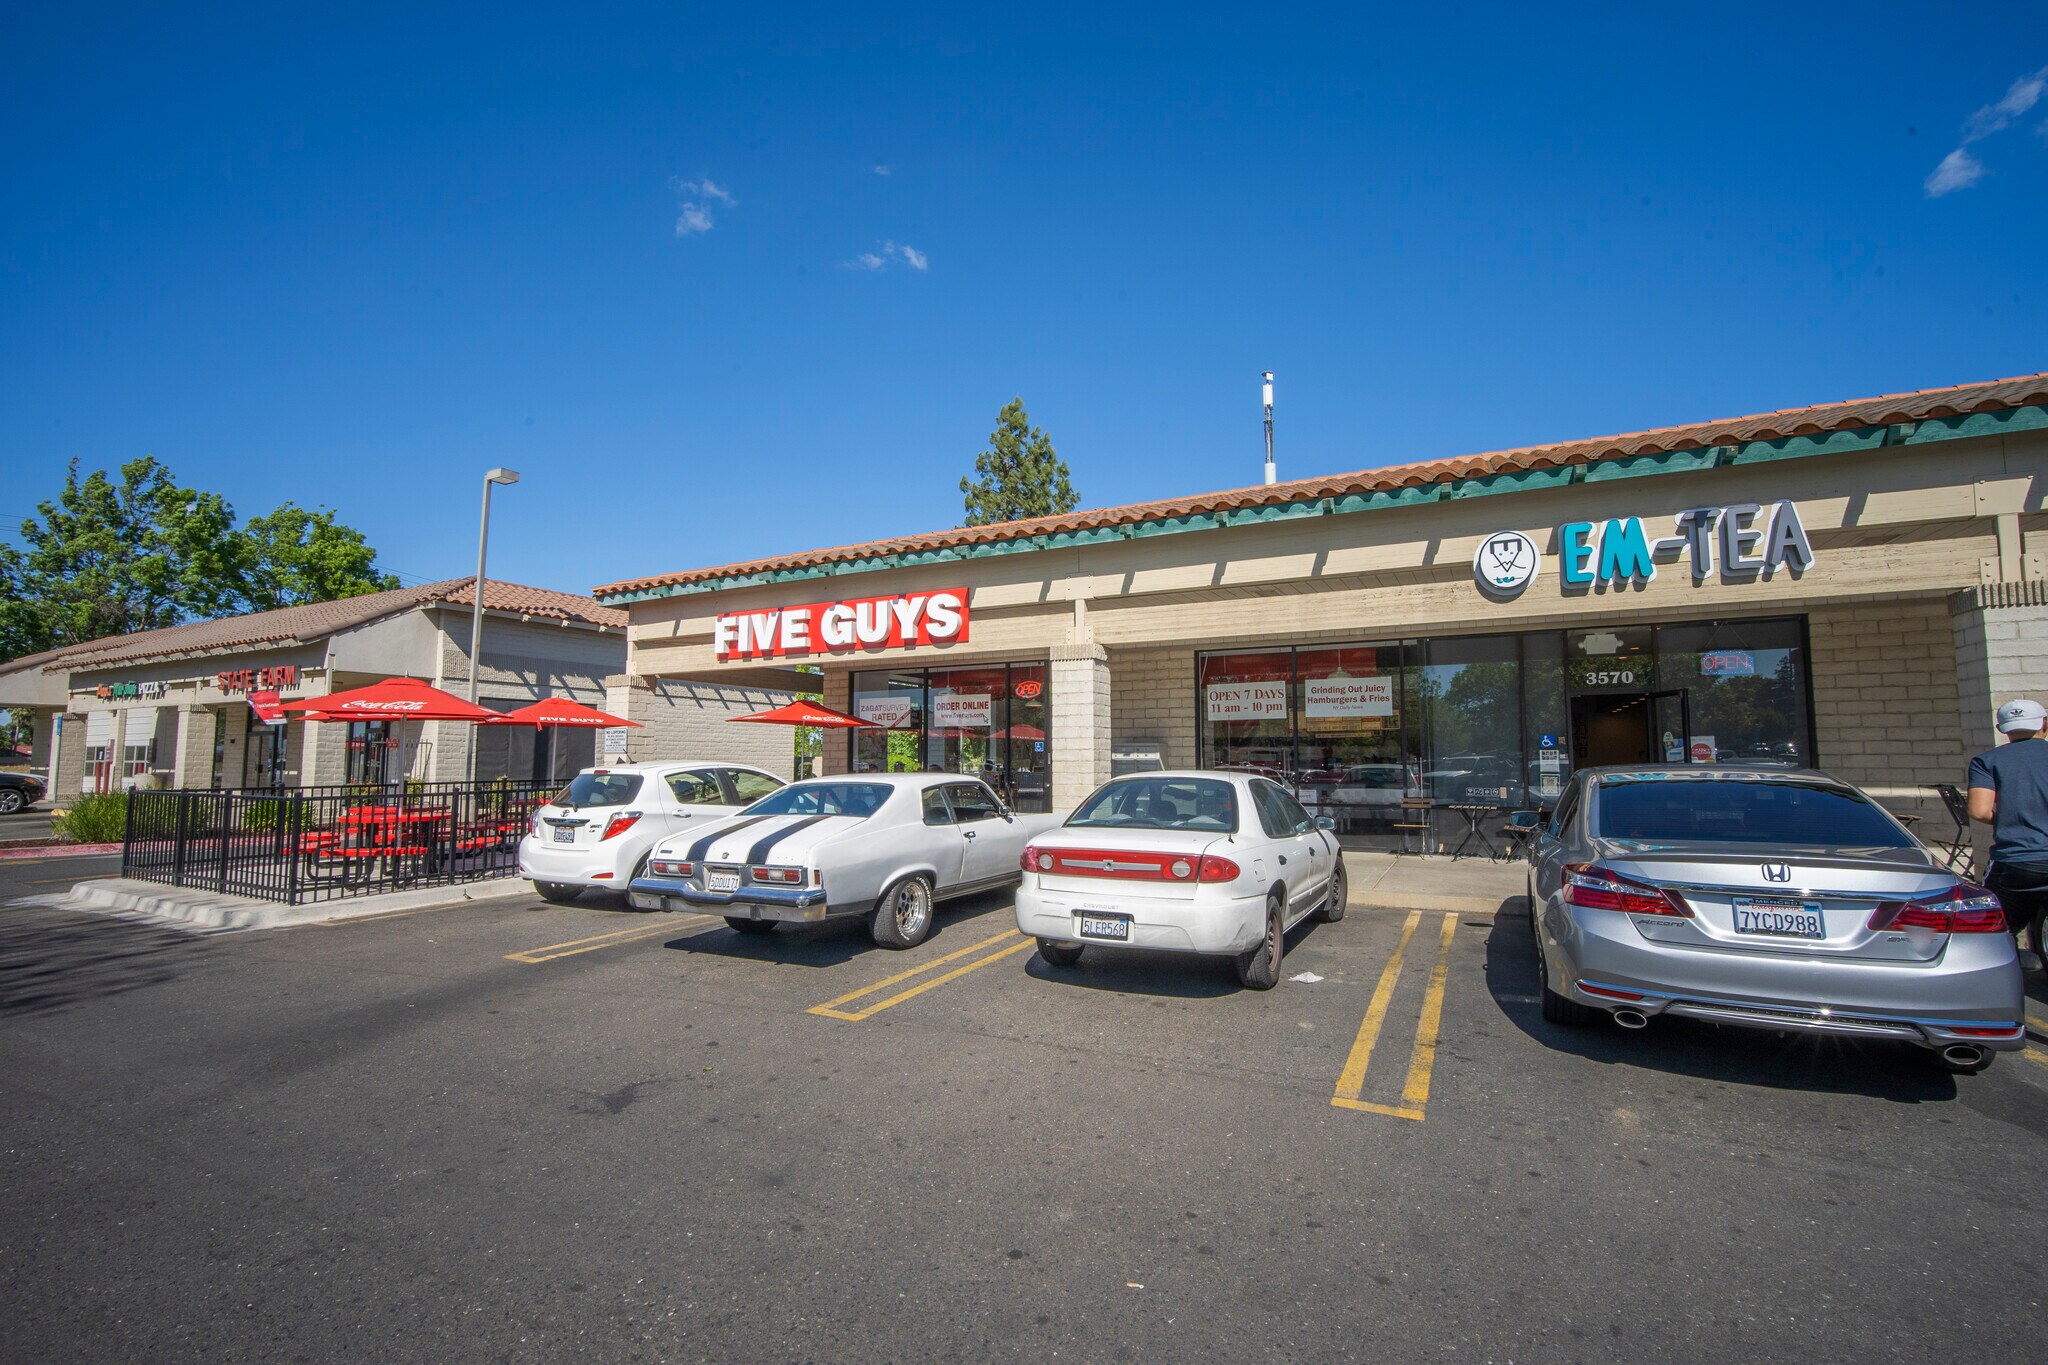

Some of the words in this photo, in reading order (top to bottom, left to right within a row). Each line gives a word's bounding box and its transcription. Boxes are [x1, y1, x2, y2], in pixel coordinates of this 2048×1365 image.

[1563, 499, 1814, 584] EM-TEA
[714, 609, 811, 654] FIVE
[820, 593, 963, 646] GUYS
[1703, 655, 1750, 671] OPEN
[217, 669, 252, 691] STATE
[260, 665, 295, 687] FARM
[1586, 671, 1634, 685] 3570
[1016, 682, 1041, 698] OPEN
[1209, 690, 1240, 702] OPEN
[1244, 689, 1251, 700] 7
[1254, 688, 1285, 700] DAYS
[1311, 686, 1346, 695] Grinding
[1347, 685, 1363, 693] Out
[1365, 684, 1386, 693] Juicy
[936, 702, 960, 711] ORDER
[962, 700, 989, 710] ONLINE
[1307, 695, 1358, 704] Hamburgers
[1359, 695, 1367, 703] &
[1369, 694, 1390, 702] Fries
[1211, 703, 1221, 713] 11
[1224, 705, 1240, 713] am
[1252, 702, 1262, 712] 10
[1265, 703, 1283, 714] pm
[871, 712, 898, 721] RATED
[1084, 920, 1125, 936] 5LER568
[1636, 919, 1686, 928] Accord
[1740, 911, 1818, 932] 7YCD988
